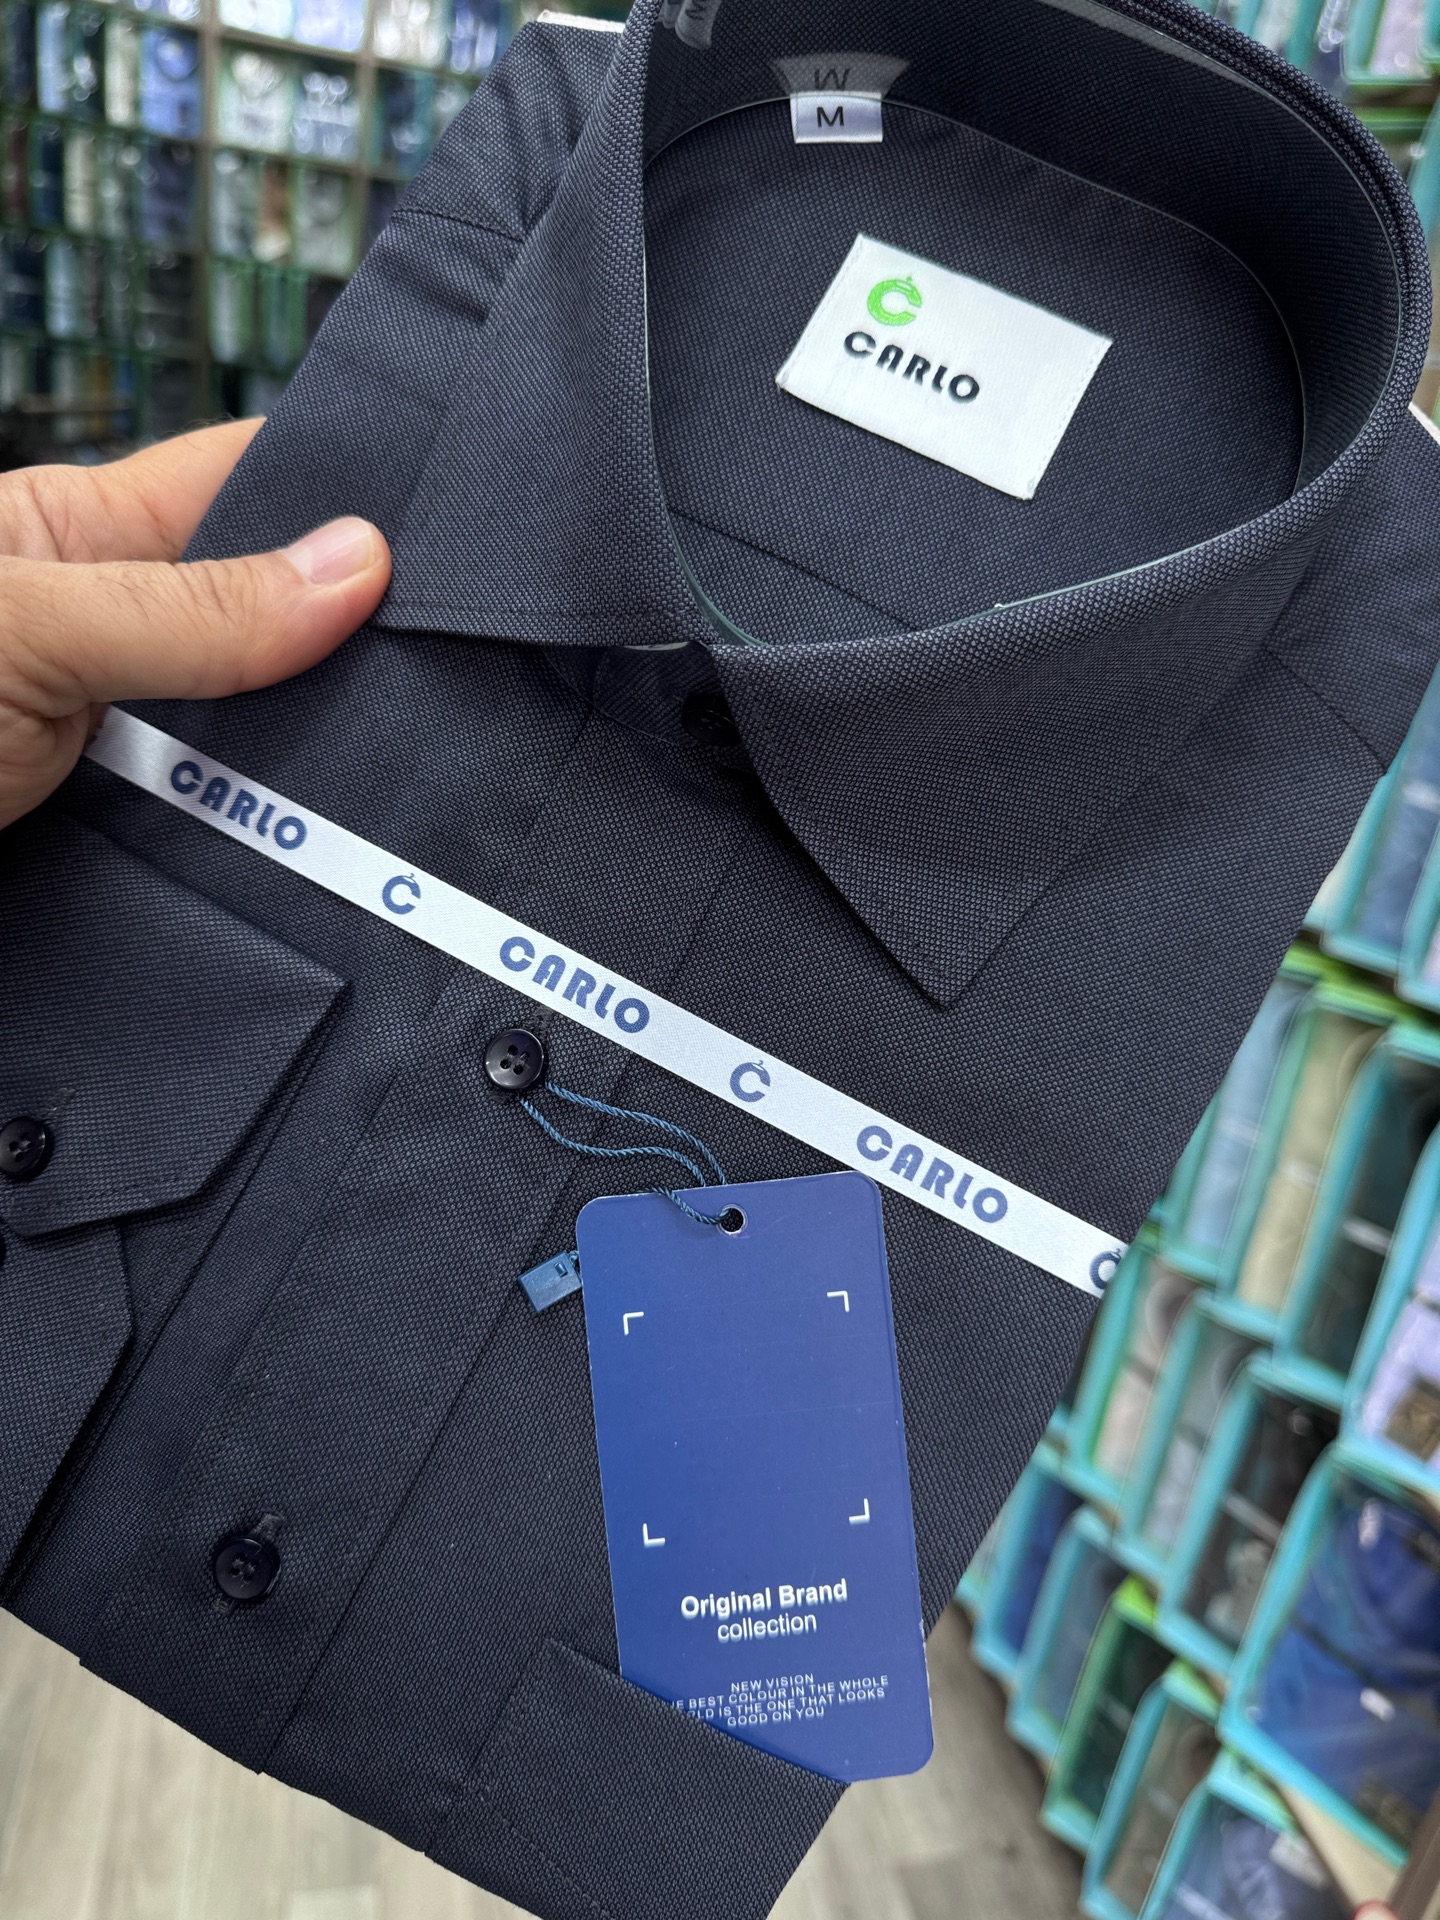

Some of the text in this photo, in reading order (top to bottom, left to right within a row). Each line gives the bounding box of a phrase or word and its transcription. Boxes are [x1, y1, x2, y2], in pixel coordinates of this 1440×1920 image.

[816, 106, 844, 127] M
[844, 330, 980, 404] CARLO
[170, 760, 307, 850] CARLO
[499, 936, 650, 1033] CARLO
[856, 1125, 1008, 1223] CARLO
[681, 1578, 848, 1620] Original Brand
[717, 1613, 817, 1643] collection
[689, 1695, 724, 1709] BEST
[729, 1688, 787, 1704] COLOUR
[791, 1686, 804, 1698] IN
[809, 1682, 835, 1695] THE
[840, 1675, 889, 1693] WHOLE
[731, 1673, 814, 1694] NEW VISION
[719, 1706, 731, 1718] IS
[736, 1702, 762, 1715] THE
[767, 1698, 795, 1712] ONE
[800, 1694, 834, 1708] THAT
[838, 1687, 885, 1704] LOOKS
[727, 1706, 825, 1727] GOOD ON YOU
